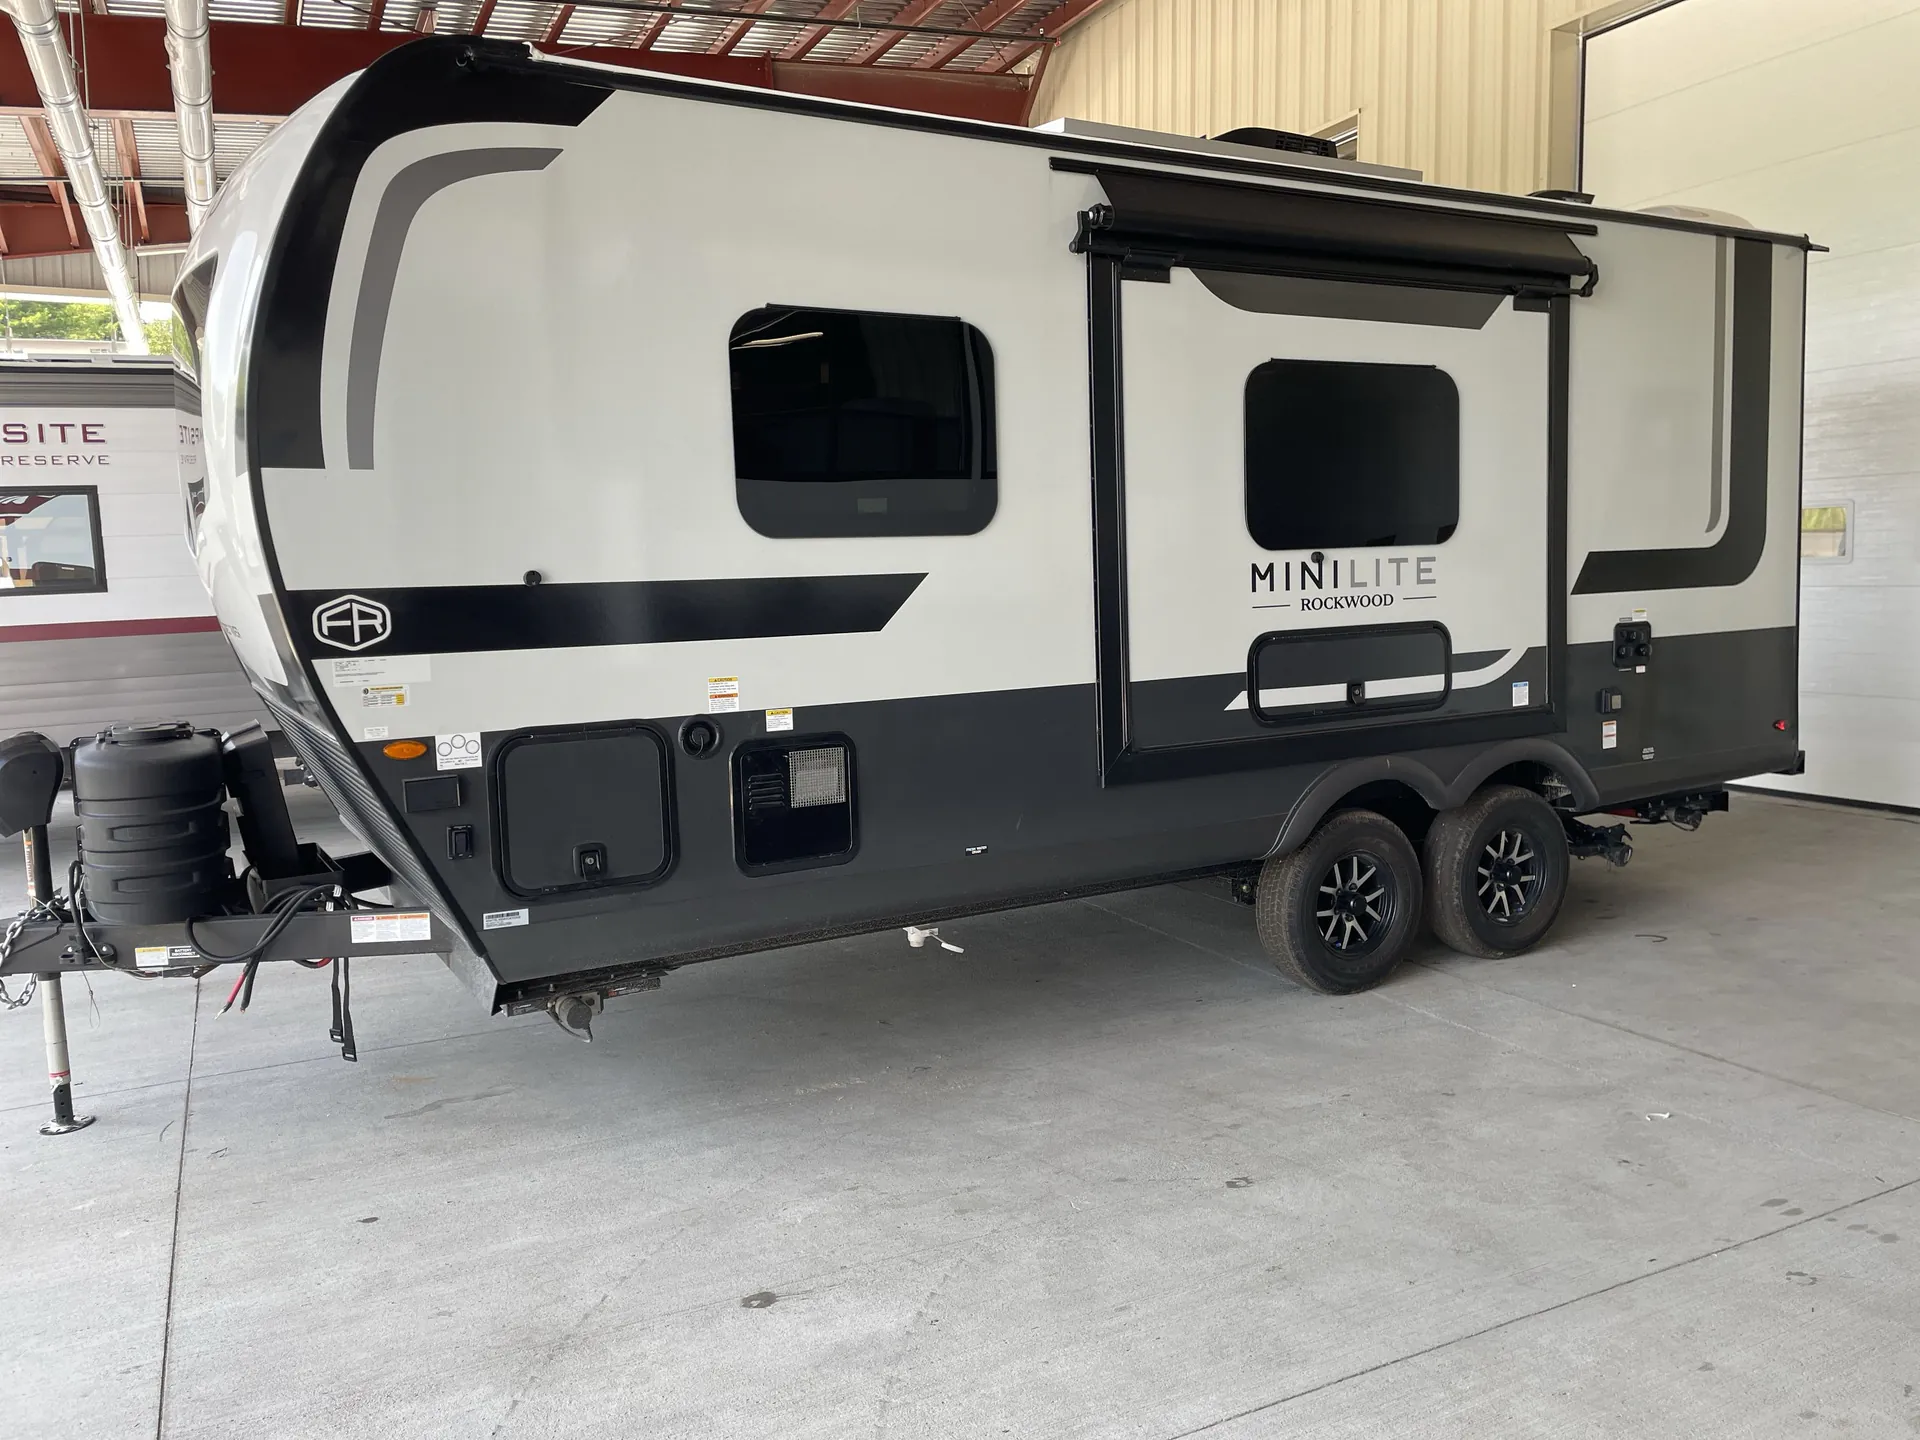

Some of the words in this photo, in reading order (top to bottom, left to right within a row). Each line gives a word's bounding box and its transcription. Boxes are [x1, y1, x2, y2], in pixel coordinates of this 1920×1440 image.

[2, 423, 107, 444] SITE
[1, 455, 110, 466] RESERVE
[1300, 593, 1394, 611] ROCKWOOD
